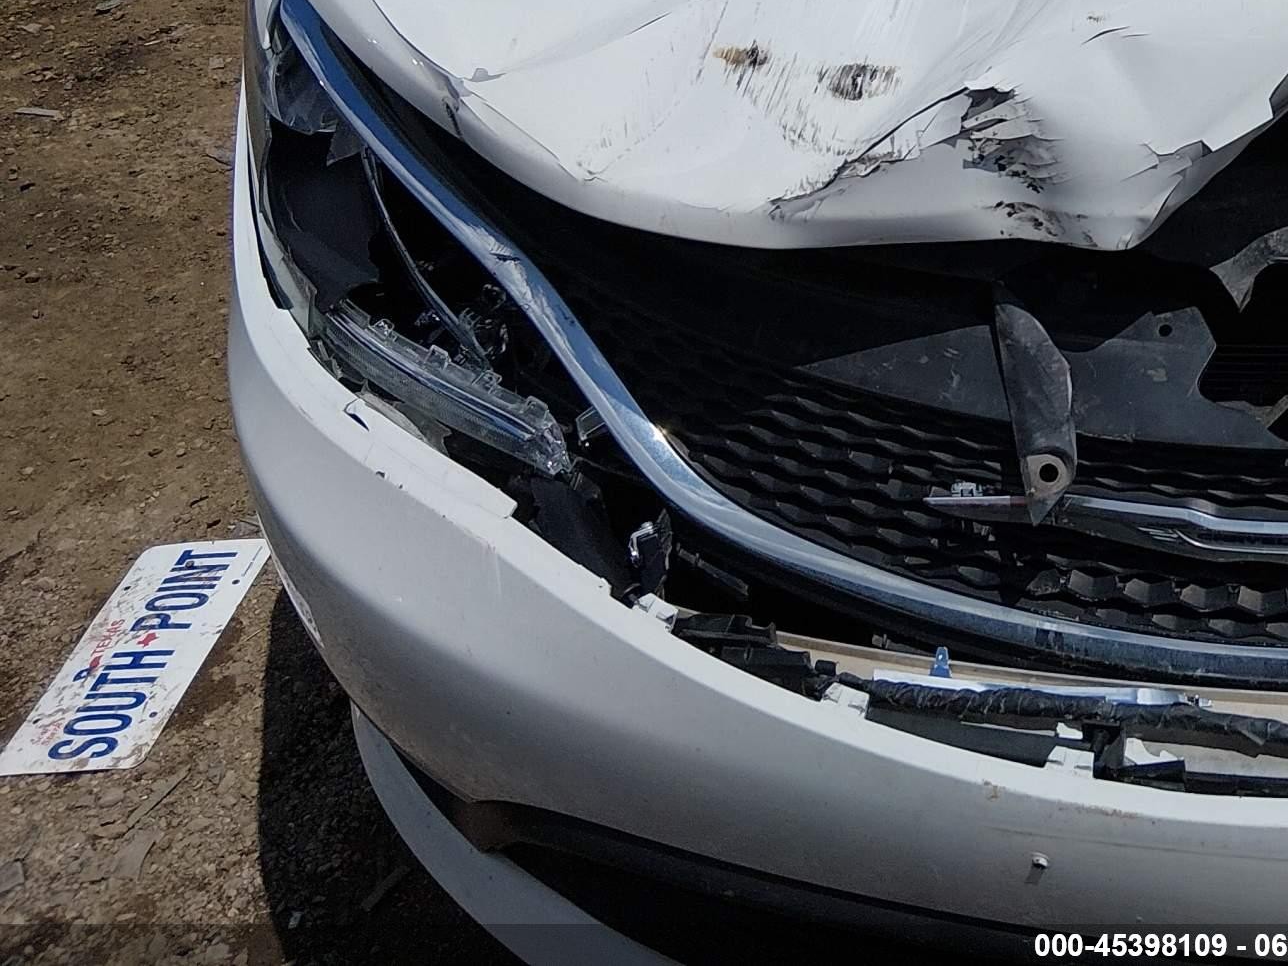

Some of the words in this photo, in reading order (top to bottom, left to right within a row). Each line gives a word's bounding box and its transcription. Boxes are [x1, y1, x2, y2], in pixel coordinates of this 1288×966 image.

[47, 649, 176, 761] SOUTH
[130, 549, 239, 631] POINT
[90, 618, 126, 658] TEXAS
